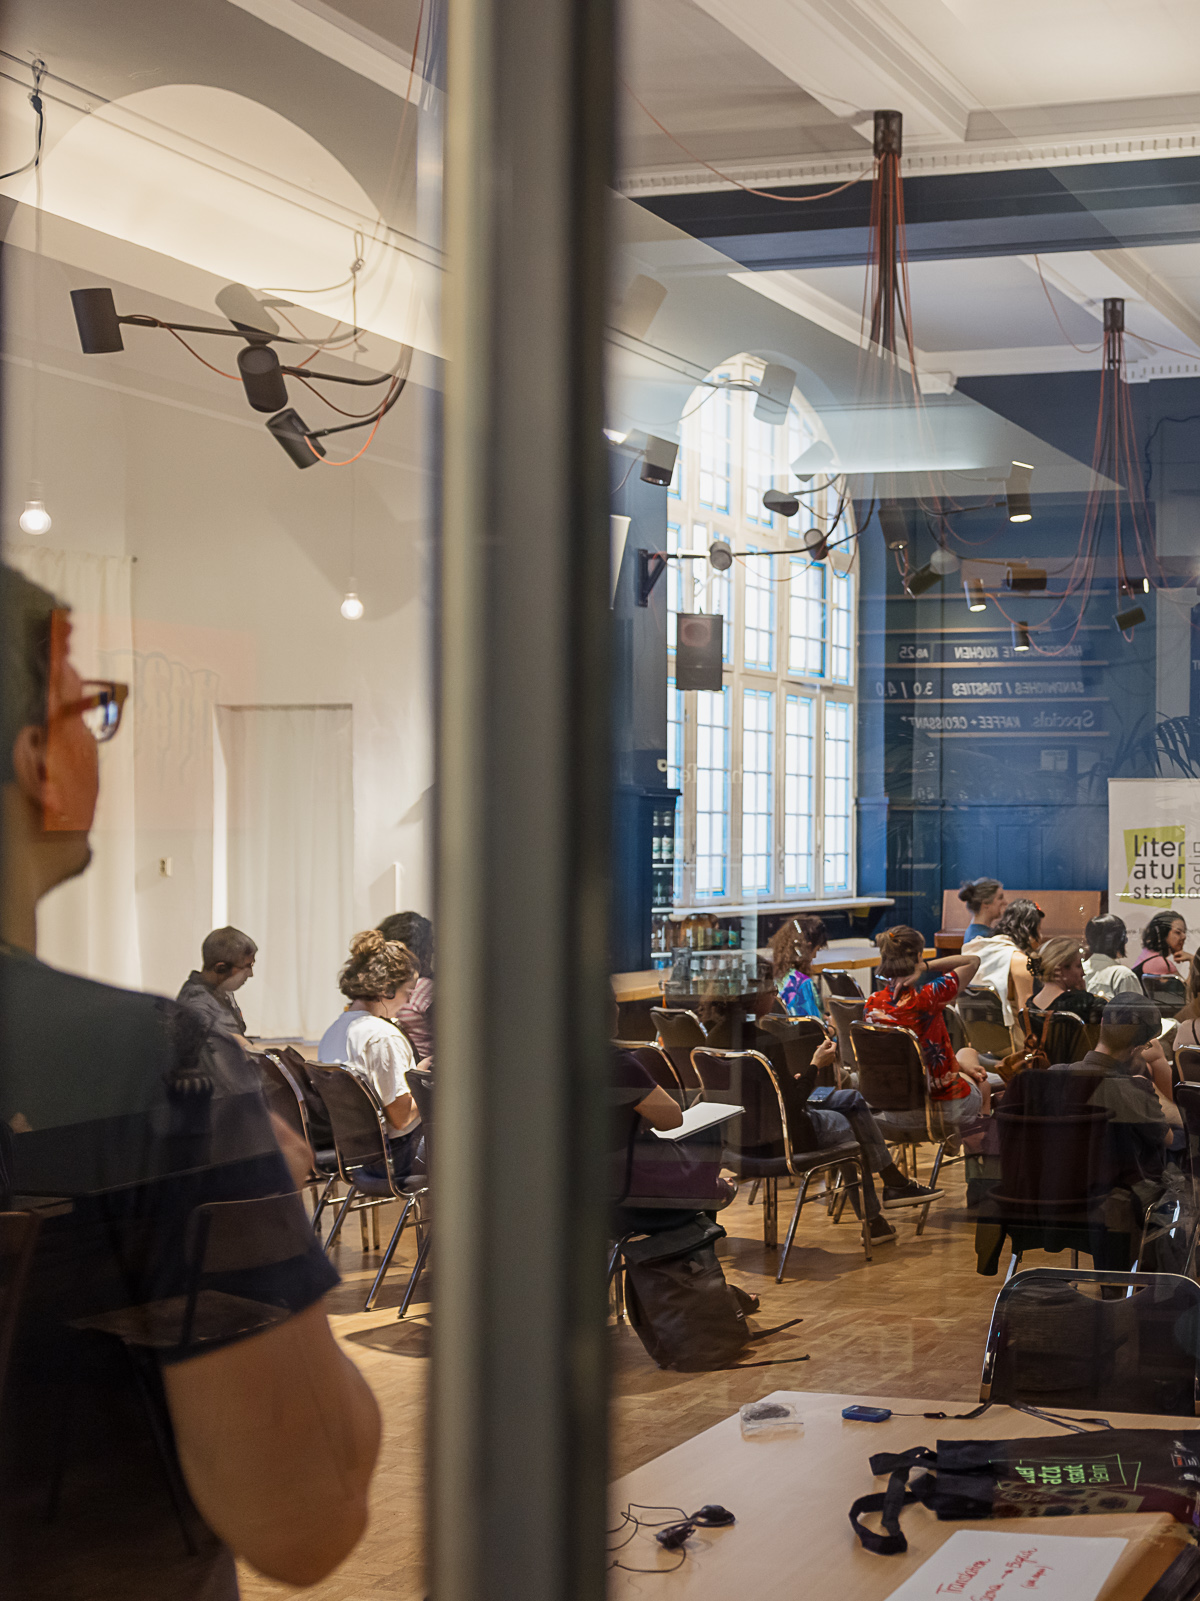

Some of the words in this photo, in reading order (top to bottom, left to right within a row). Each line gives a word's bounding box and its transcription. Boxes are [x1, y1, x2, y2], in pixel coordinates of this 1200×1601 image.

[1134, 834, 1184, 857] liter
[1134, 860, 1184, 880] atur
[1134, 882, 1184, 900] stadt
